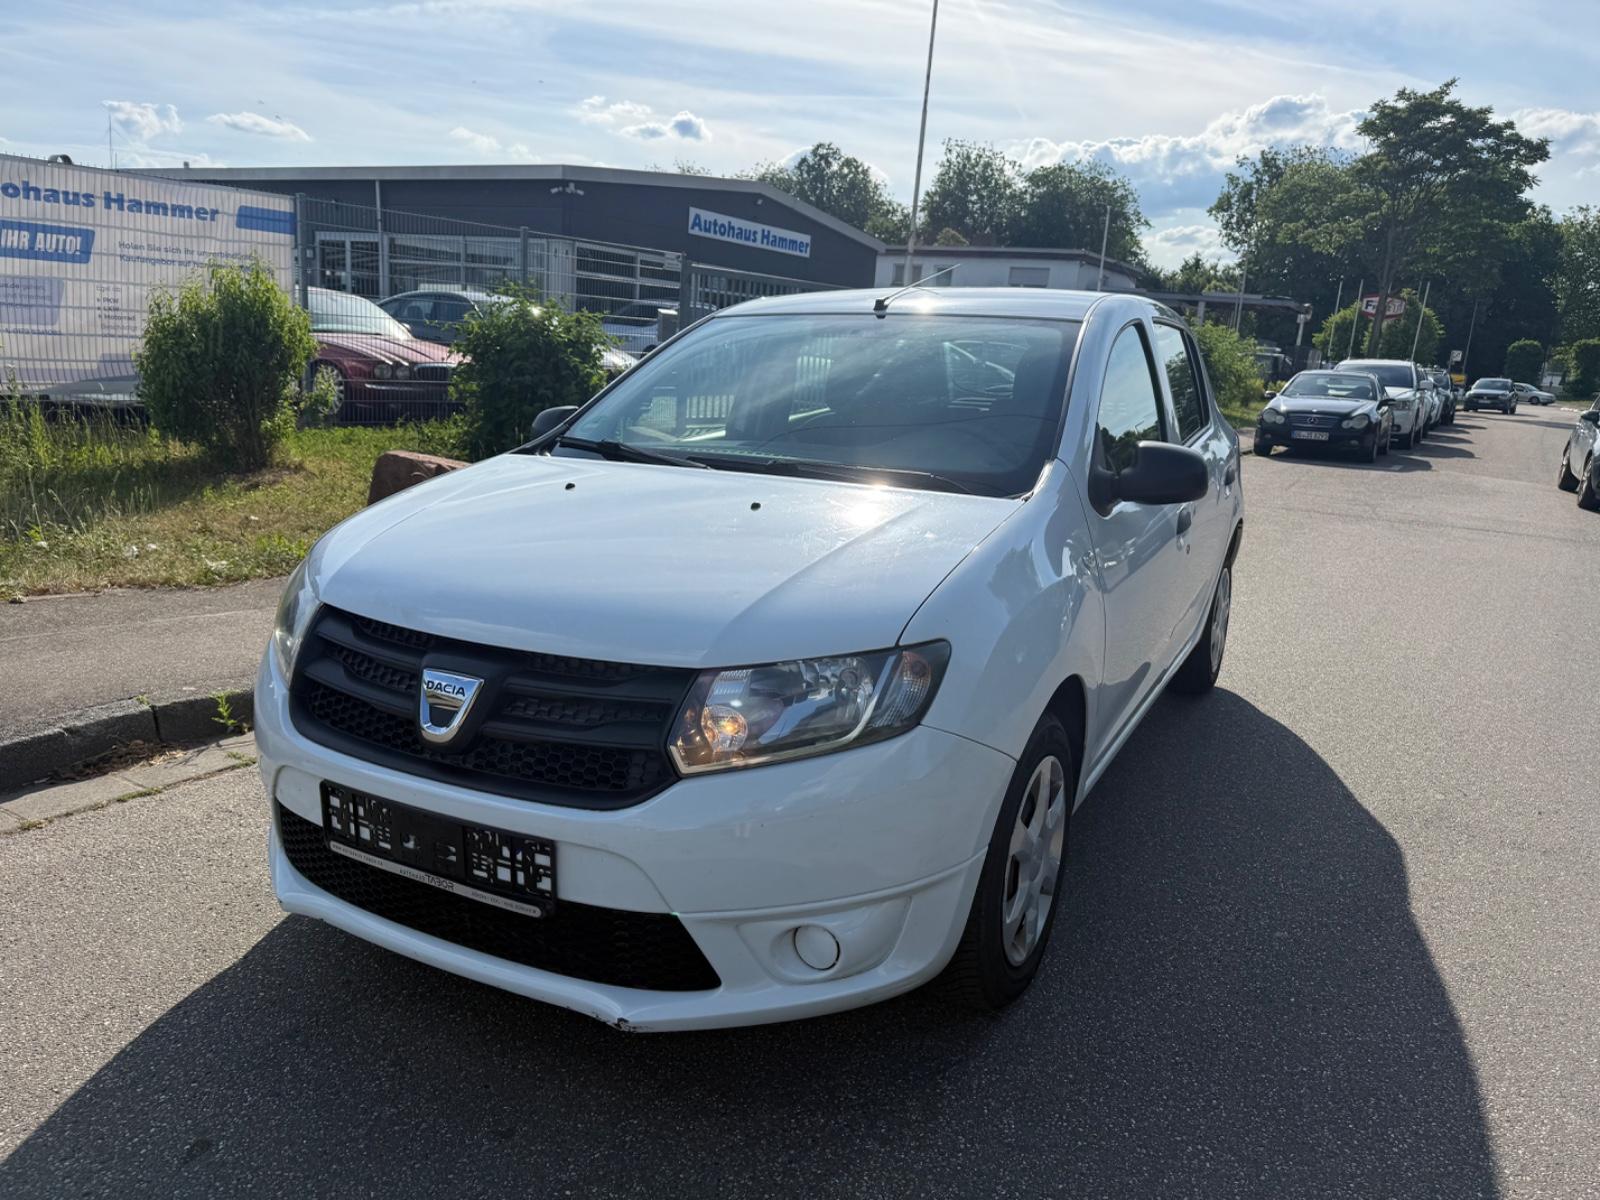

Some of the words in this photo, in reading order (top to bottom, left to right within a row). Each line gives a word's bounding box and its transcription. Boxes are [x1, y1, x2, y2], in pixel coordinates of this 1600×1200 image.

[1, 180, 96, 208] ohaus
[103, 191, 219, 222] Hammer
[0, 228, 30, 250] IHR
[35, 232, 82, 256] AUTO!
[690, 213, 758, 243] Autohaus
[760, 228, 810, 254] Hammer
[426, 680, 466, 697] DACIA
[424, 873, 456, 892] TABOR
